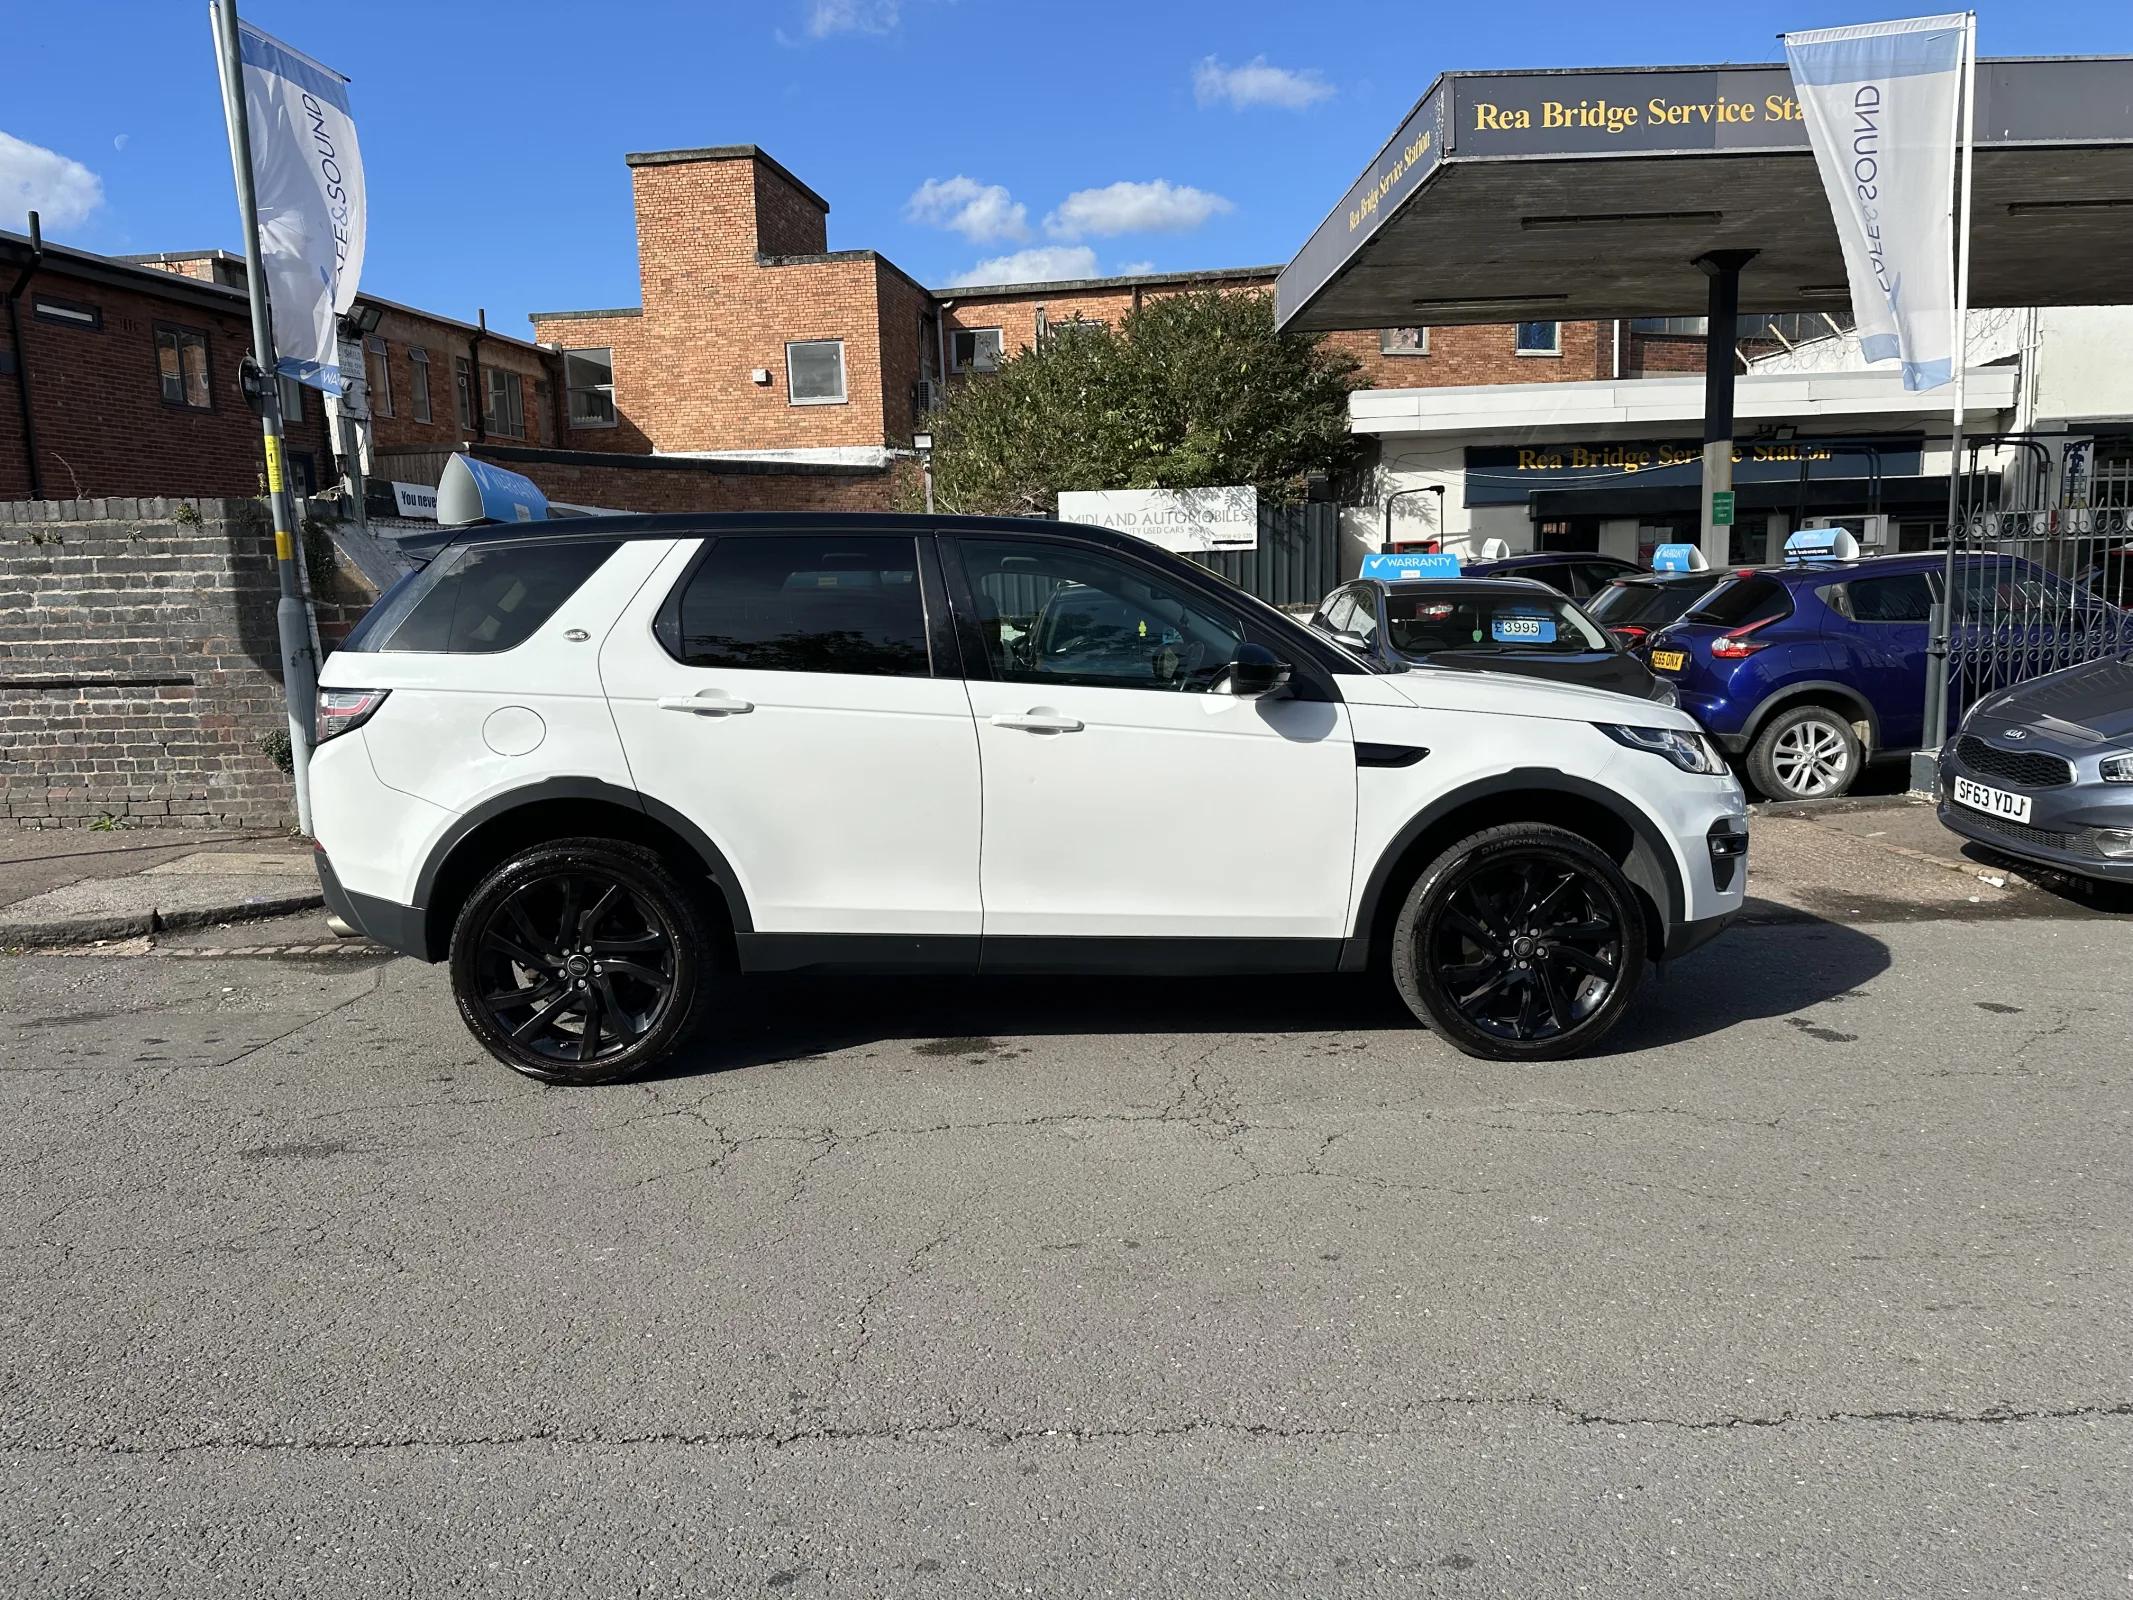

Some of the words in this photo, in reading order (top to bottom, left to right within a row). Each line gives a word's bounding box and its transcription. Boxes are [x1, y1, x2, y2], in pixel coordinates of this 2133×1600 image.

[1474, 103, 1531, 130] Rea
[1541, 100, 1638, 133] Bridge
[1648, 97, 1756, 126] Service
[1764, 95, 1805, 122] Sta
[1349, 210, 1360, 233] Rea
[1361, 188, 1379, 220] Bridge
[1379, 160, 1403, 199] Service
[1404, 130, 1431, 172] Station
[268, 453, 274, 463] 1
[1516, 450, 1562, 470] Rea
[1571, 448, 1650, 472] Bridge
[1658, 444, 1743, 465] Sere
[401, 490, 418, 507] You
[417, 494, 438, 508] neve
[1068, 512, 1137, 527] MIDLAND
[1141, 510, 1248, 526] AUTOMOBILES
[1143, 526, 1163, 535] USED
[1163, 525, 1185, 534] CARS
[1386, 557, 1452, 567] WARRANTY
[1495, 621, 1540, 633] £3995
[2005, 729, 2025, 739] KIA
[1959, 780, 1990, 807] SF63
[1994, 791, 2024, 817] YDJ
